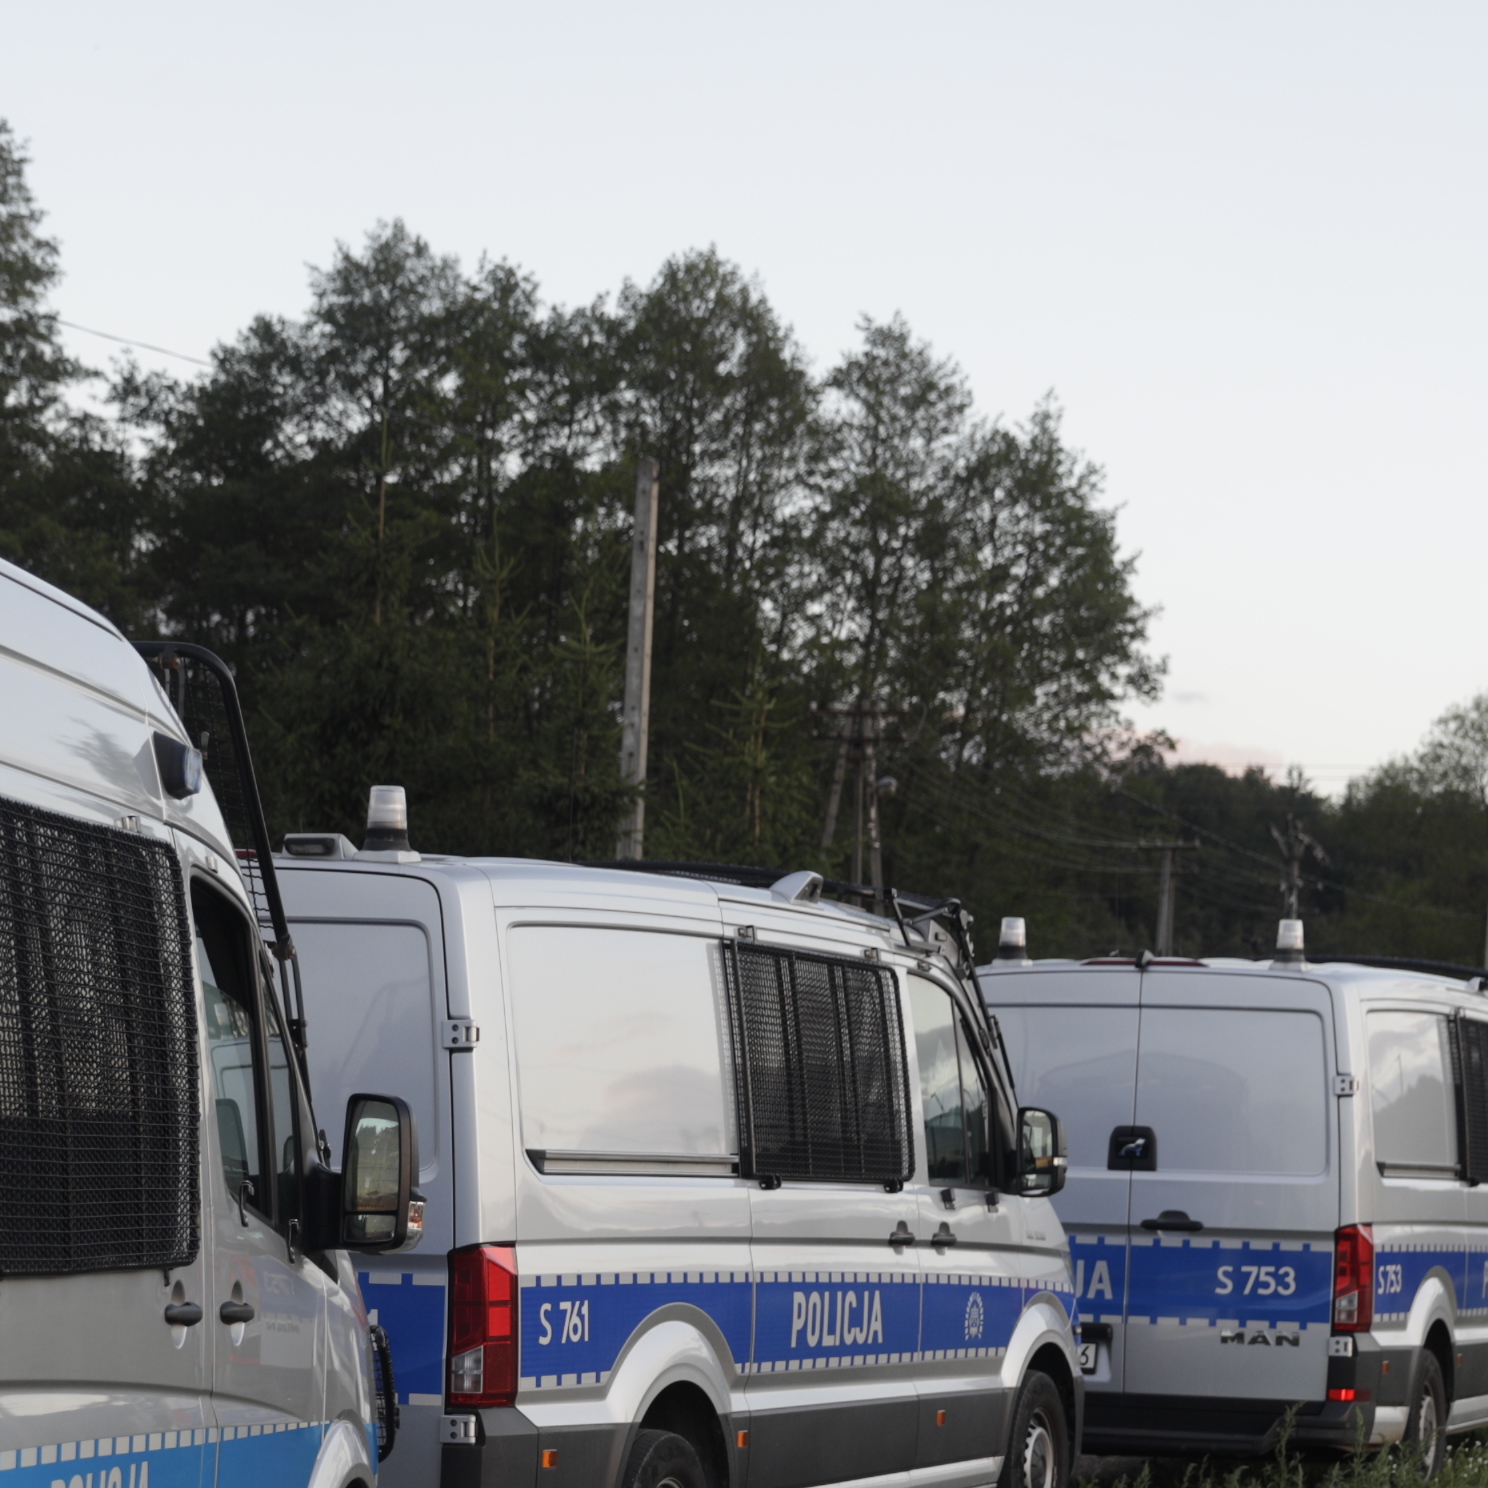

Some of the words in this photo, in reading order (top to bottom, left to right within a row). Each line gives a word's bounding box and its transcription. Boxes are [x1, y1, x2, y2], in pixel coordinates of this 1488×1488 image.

[1214, 1265, 1234, 1296] S
[1240, 1265, 1297, 1296] 753
[1377, 1265, 1386, 1295] S
[1385, 1263, 1402, 1294] 753
[538, 1302, 553, 1346] S
[559, 1299, 589, 1344] 761
[790, 1289, 884, 1349] POLICJA
[1220, 1329, 1300, 1347] MAN
